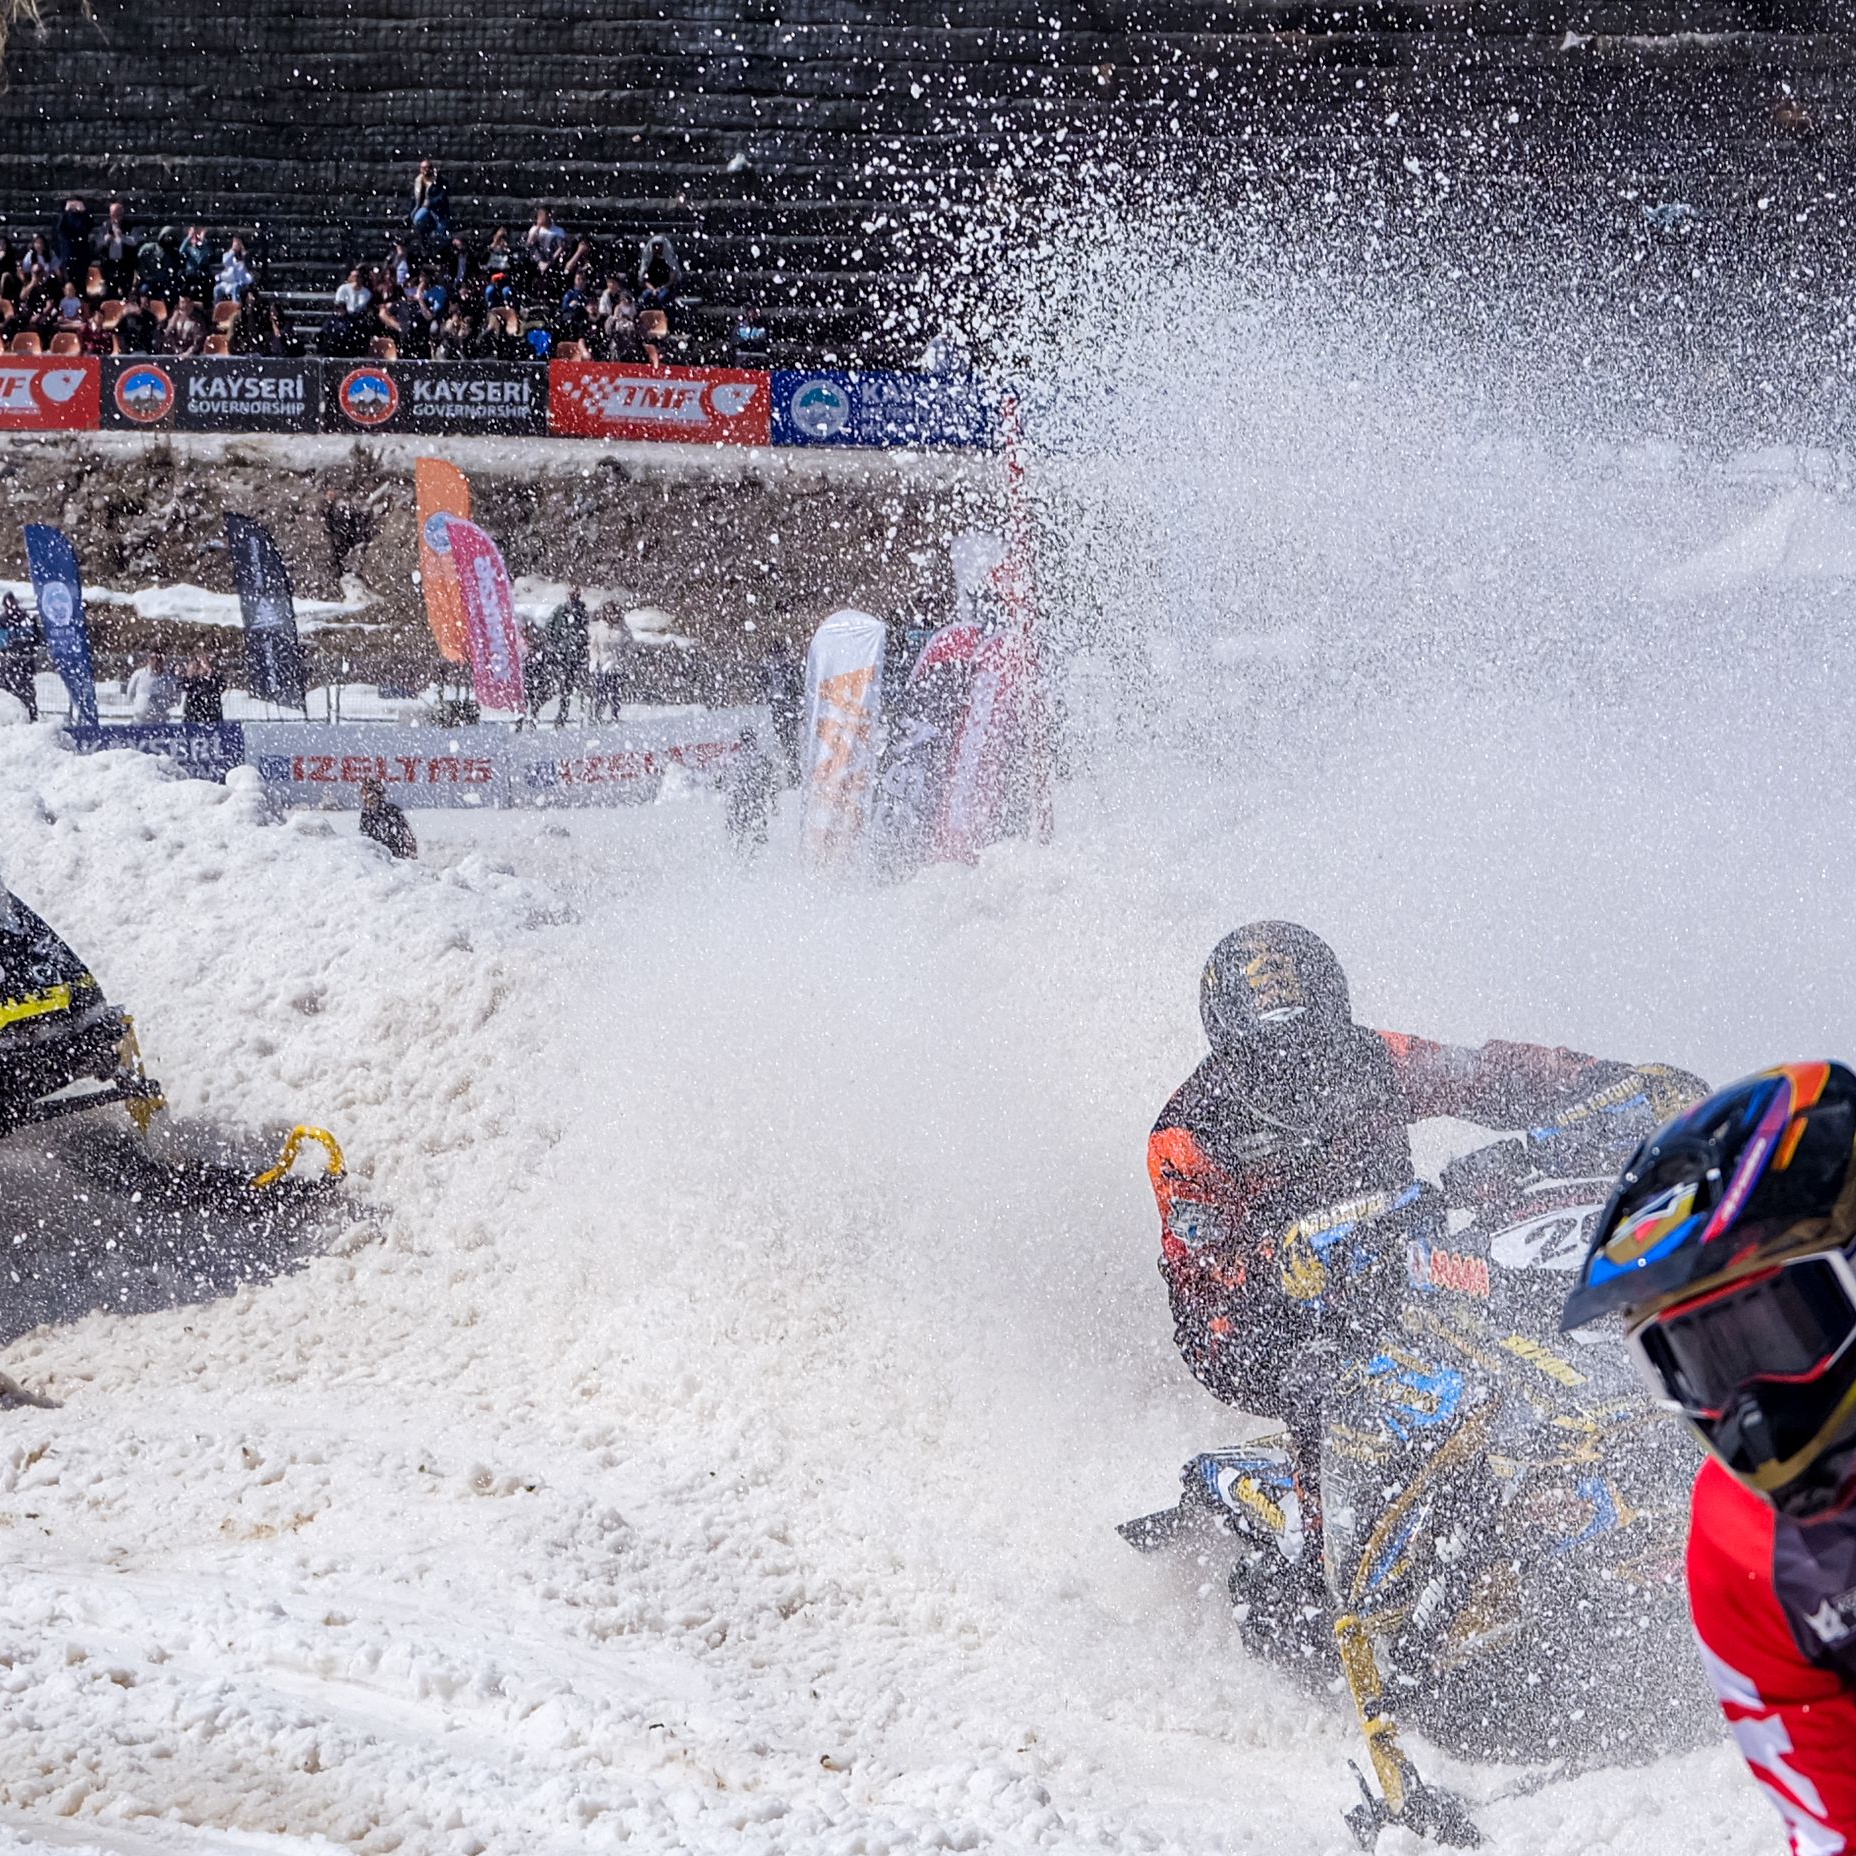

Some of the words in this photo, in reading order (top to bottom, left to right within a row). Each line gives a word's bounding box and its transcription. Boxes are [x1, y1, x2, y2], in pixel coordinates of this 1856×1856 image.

[188, 374, 305, 399] KAYSERİ
[413, 378, 531, 402] KAYSERİ
[620, 383, 699, 410] TMF
[187, 402, 305, 416] GOVERNORSHIP
[413, 404, 530, 419] GOVERNORSHIP
